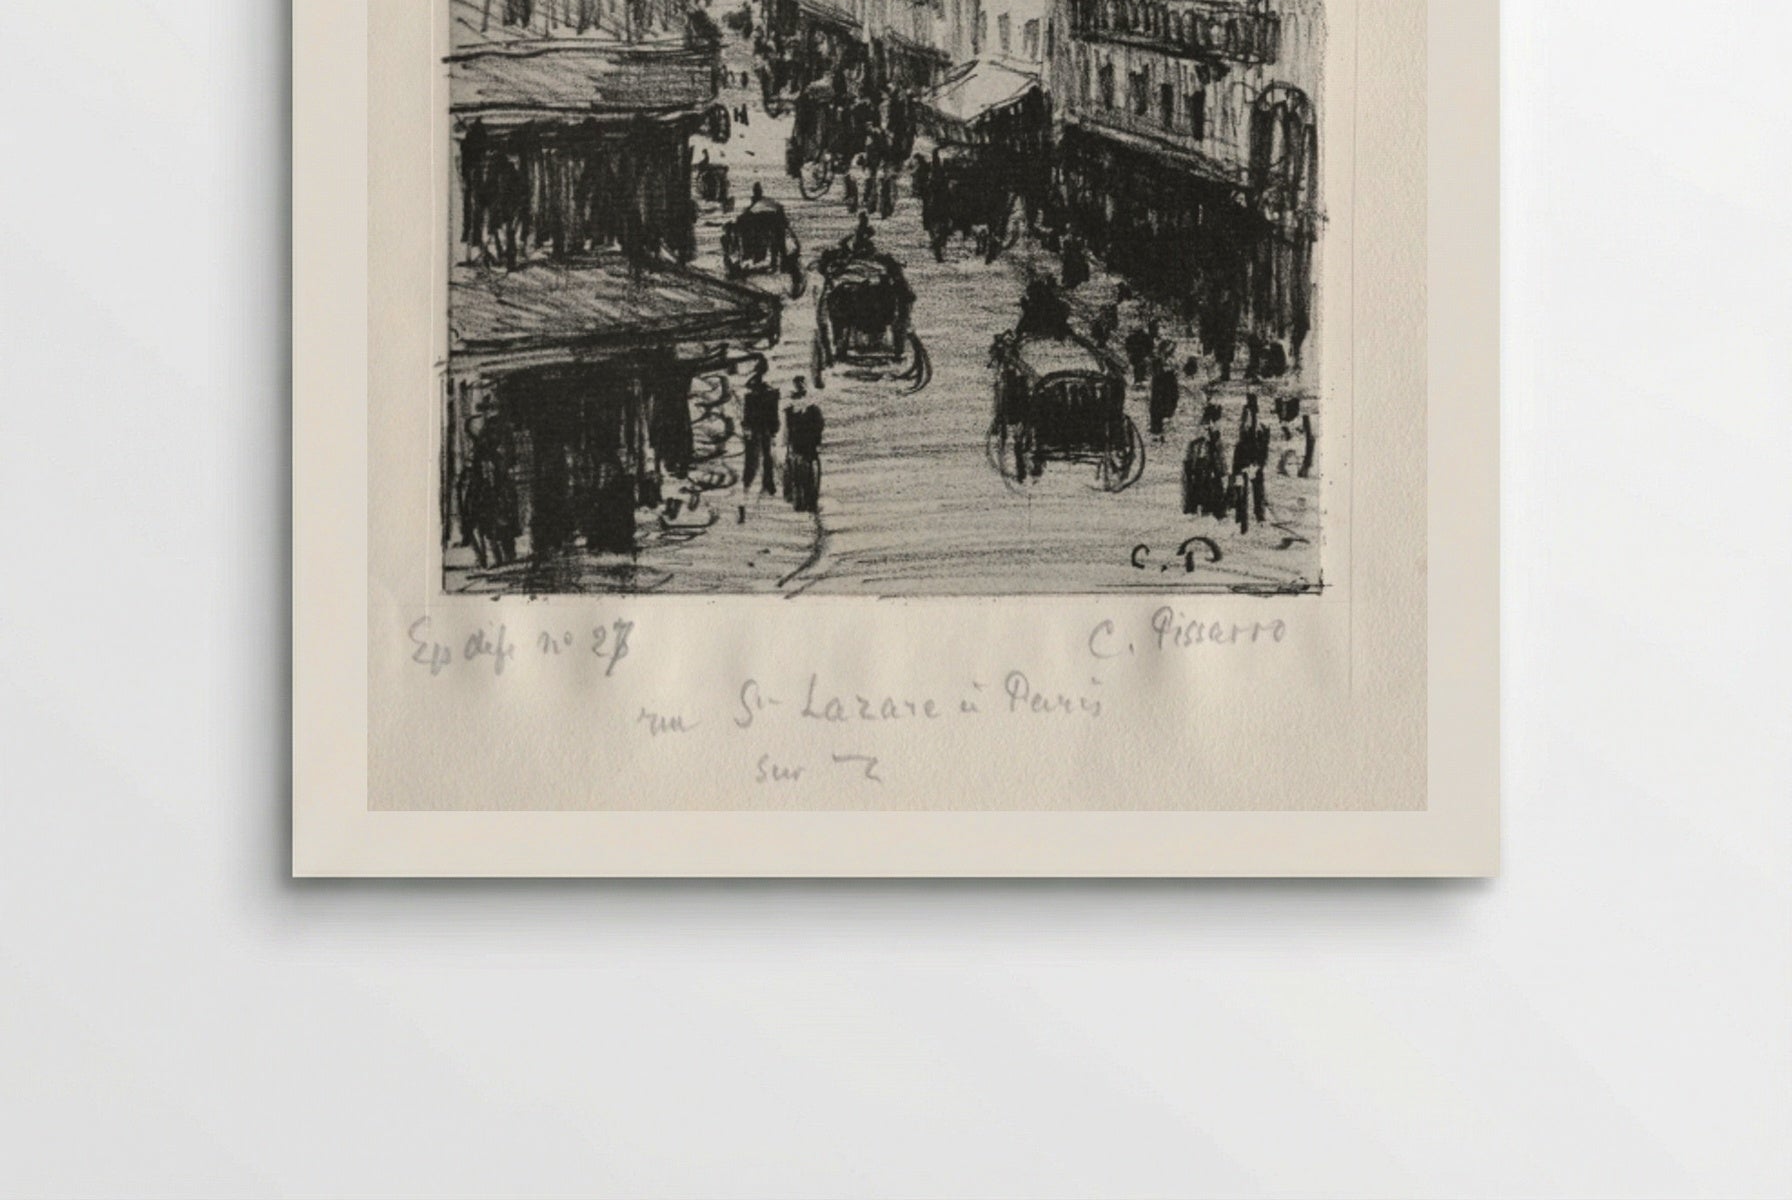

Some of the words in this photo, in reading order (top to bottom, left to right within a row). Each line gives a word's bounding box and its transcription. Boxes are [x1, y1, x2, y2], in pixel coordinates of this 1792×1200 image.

[1151, 605, 1286, 650] Pissarro
[801, 673, 942, 723] Lazare
[1004, 670, 1103, 717] Paris
